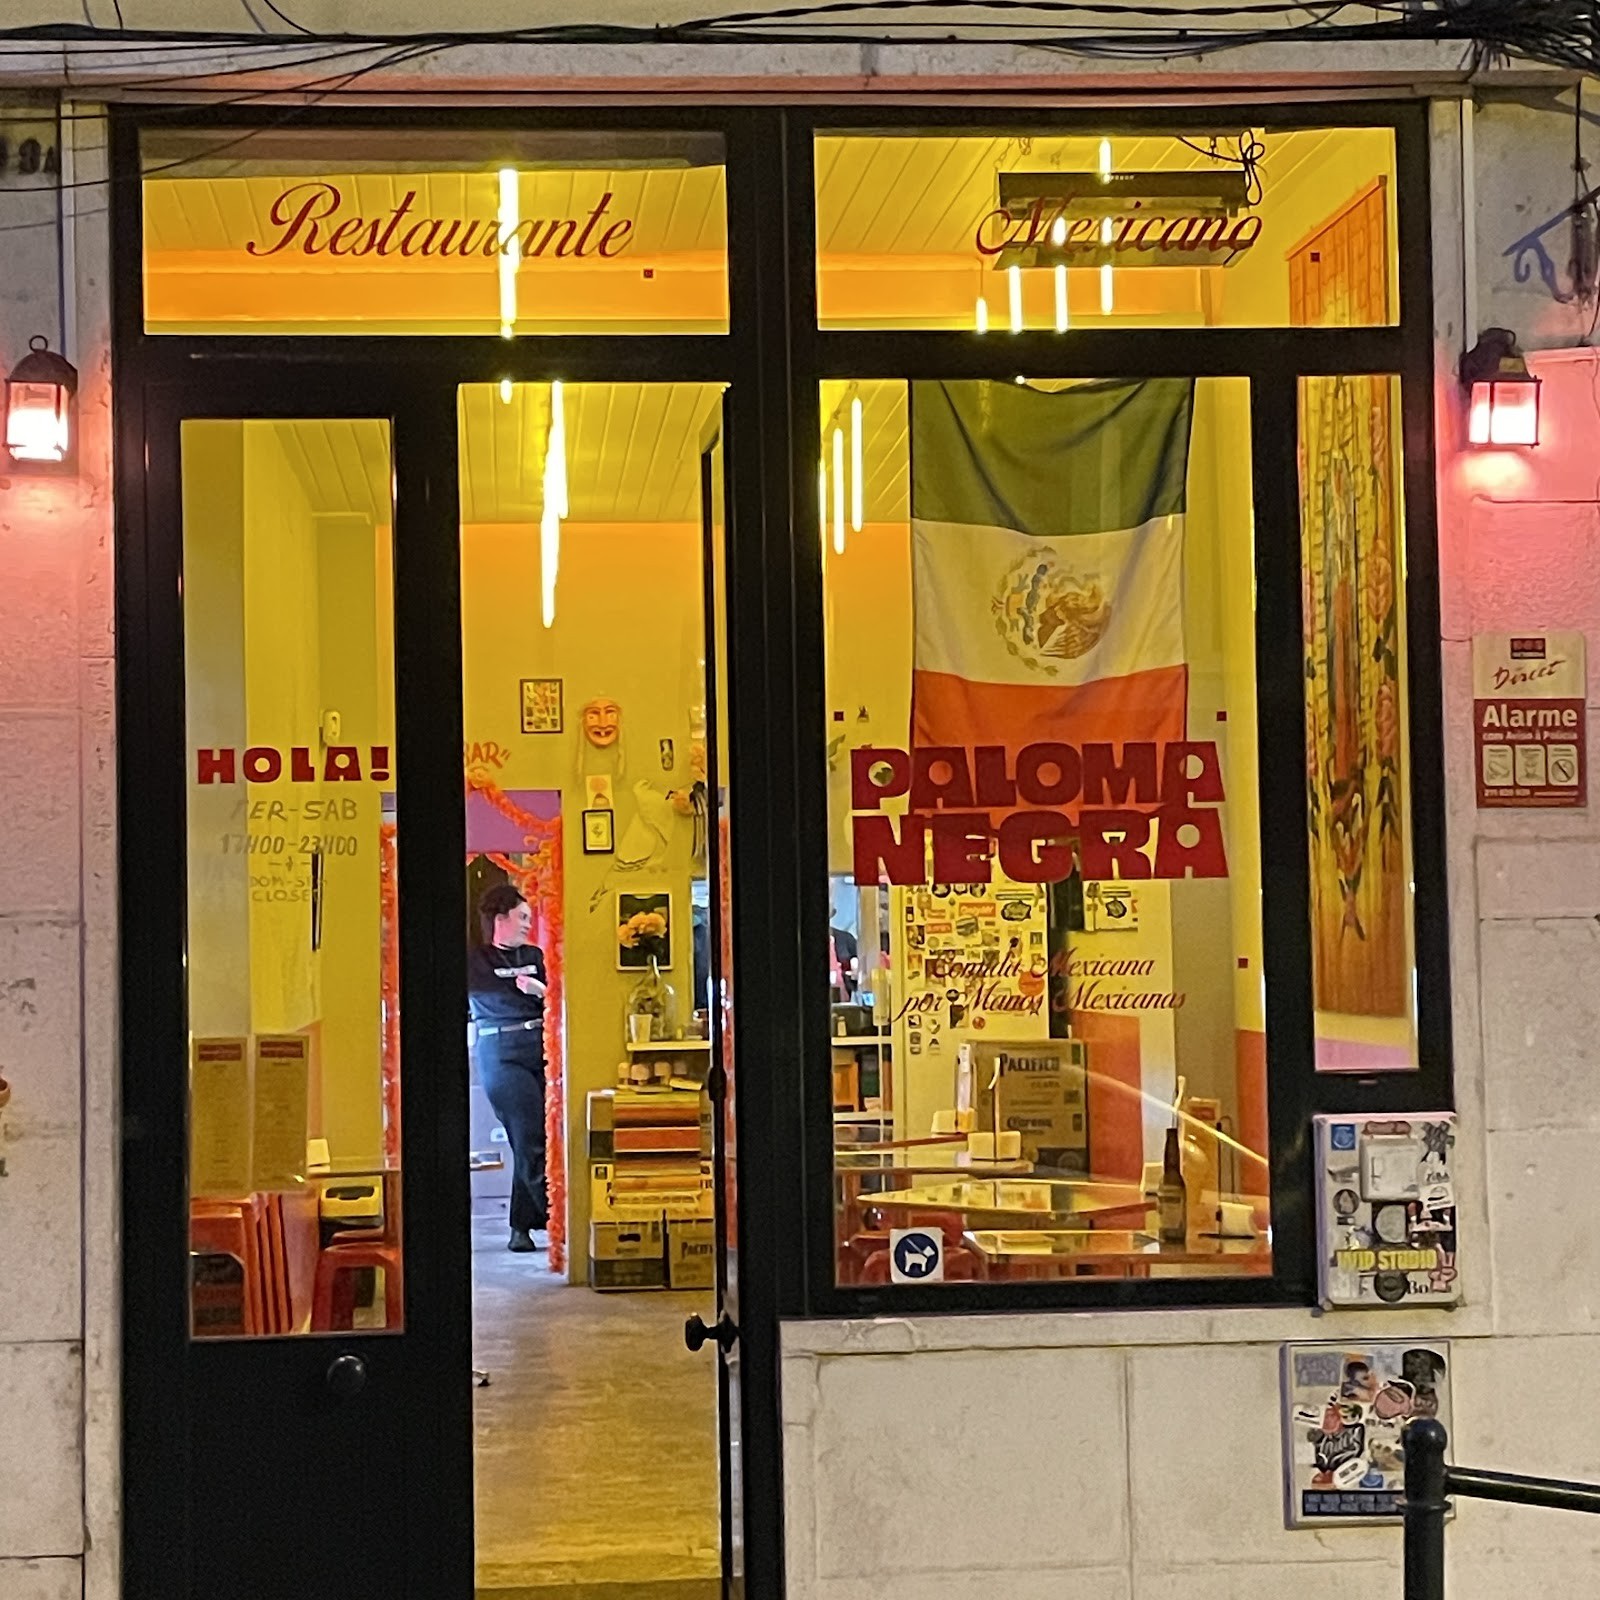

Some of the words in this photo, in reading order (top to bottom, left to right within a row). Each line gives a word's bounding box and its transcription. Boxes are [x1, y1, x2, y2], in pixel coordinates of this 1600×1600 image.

[246, 182, 633, 258] Restaurante
[976, 192, 1263, 255] Mexicano
[1482, 703, 1578, 728] Alarme
[197, 745, 390, 784] HOLA!
[851, 741, 1227, 811] PALOMA
[852, 807, 1230, 886] NEGRA
[931, 939, 1023, 979] Comida
[1030, 947, 1156, 979] Mexicana
[891, 992, 944, 1023] por
[954, 980, 1045, 1013] Manos
[1052, 979, 1187, 1013] Mexicanas
